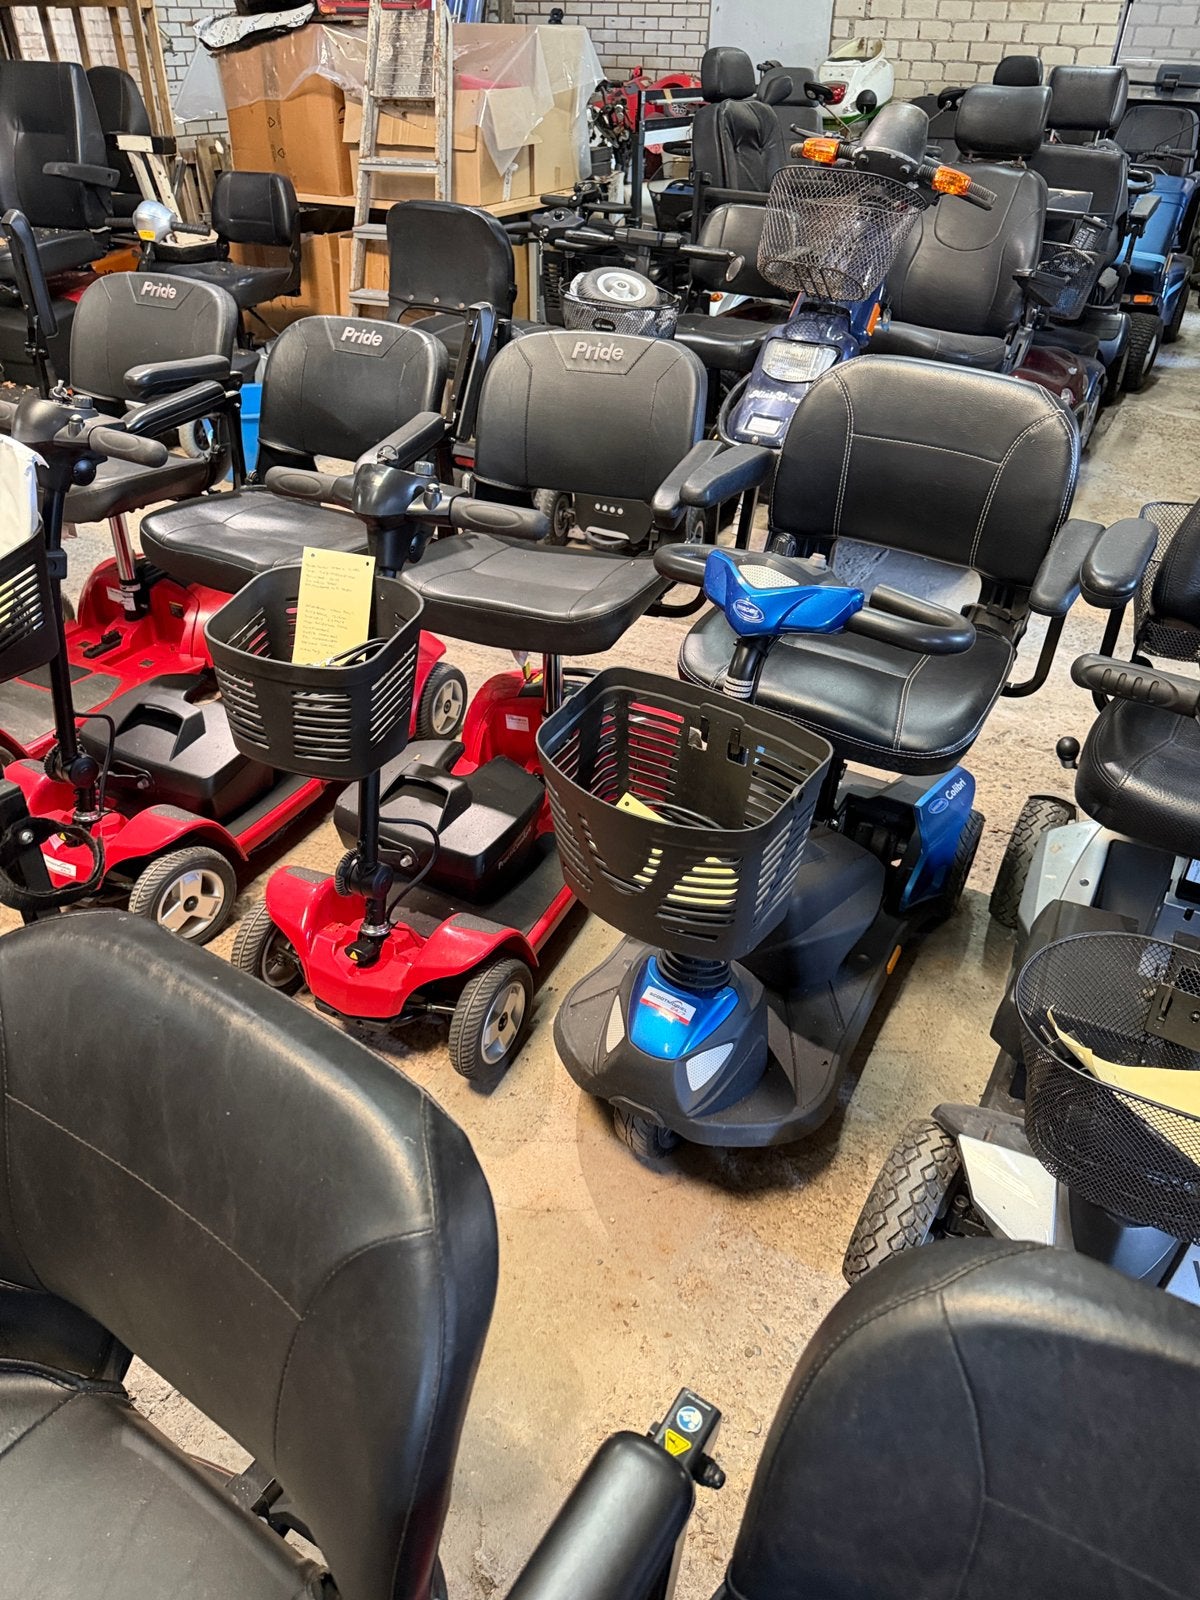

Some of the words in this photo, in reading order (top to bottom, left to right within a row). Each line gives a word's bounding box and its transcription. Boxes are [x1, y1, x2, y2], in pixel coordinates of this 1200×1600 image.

[140, 281, 177, 299] Pride
[340, 326, 383, 347] Pride
[571, 341, 624, 361] Pride
[945, 777, 967, 800] Colibri
